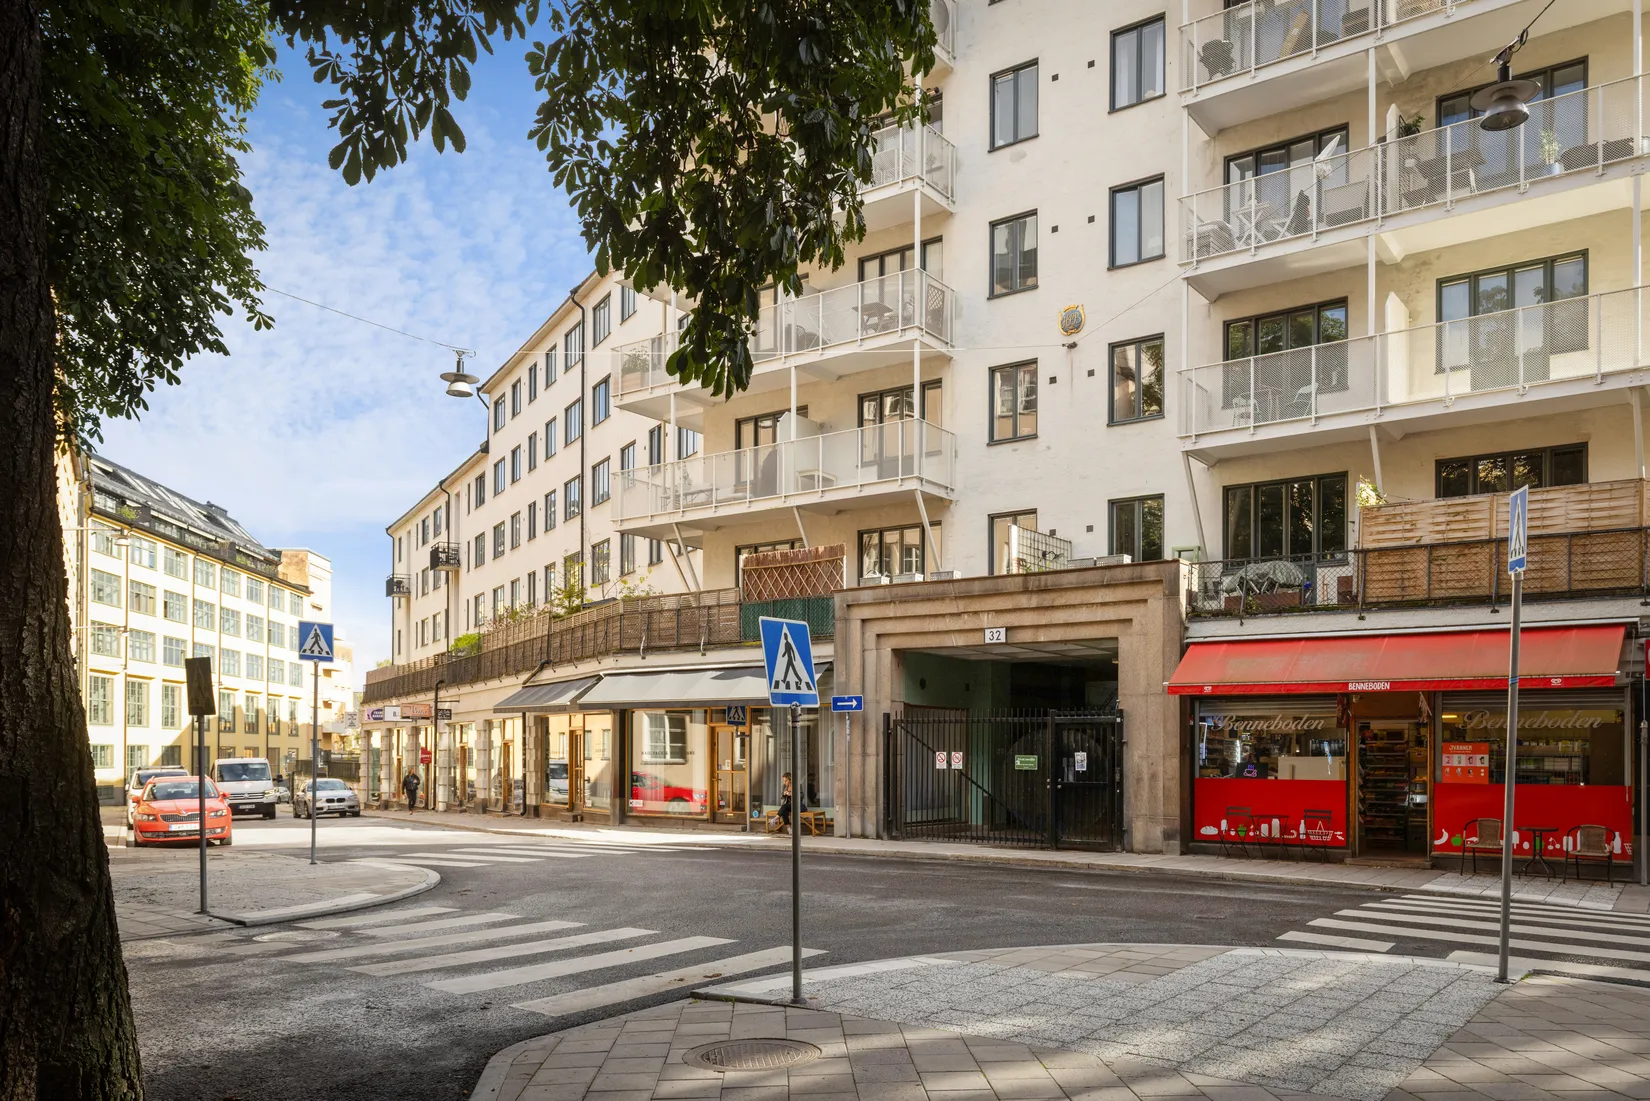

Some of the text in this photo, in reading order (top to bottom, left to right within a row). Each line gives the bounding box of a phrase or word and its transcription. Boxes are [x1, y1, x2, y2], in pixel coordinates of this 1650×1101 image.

[989, 630, 1001, 641] 32
[1348, 682, 1391, 691] BENNEBODEN
[1211, 713, 1326, 731] Benneboden
